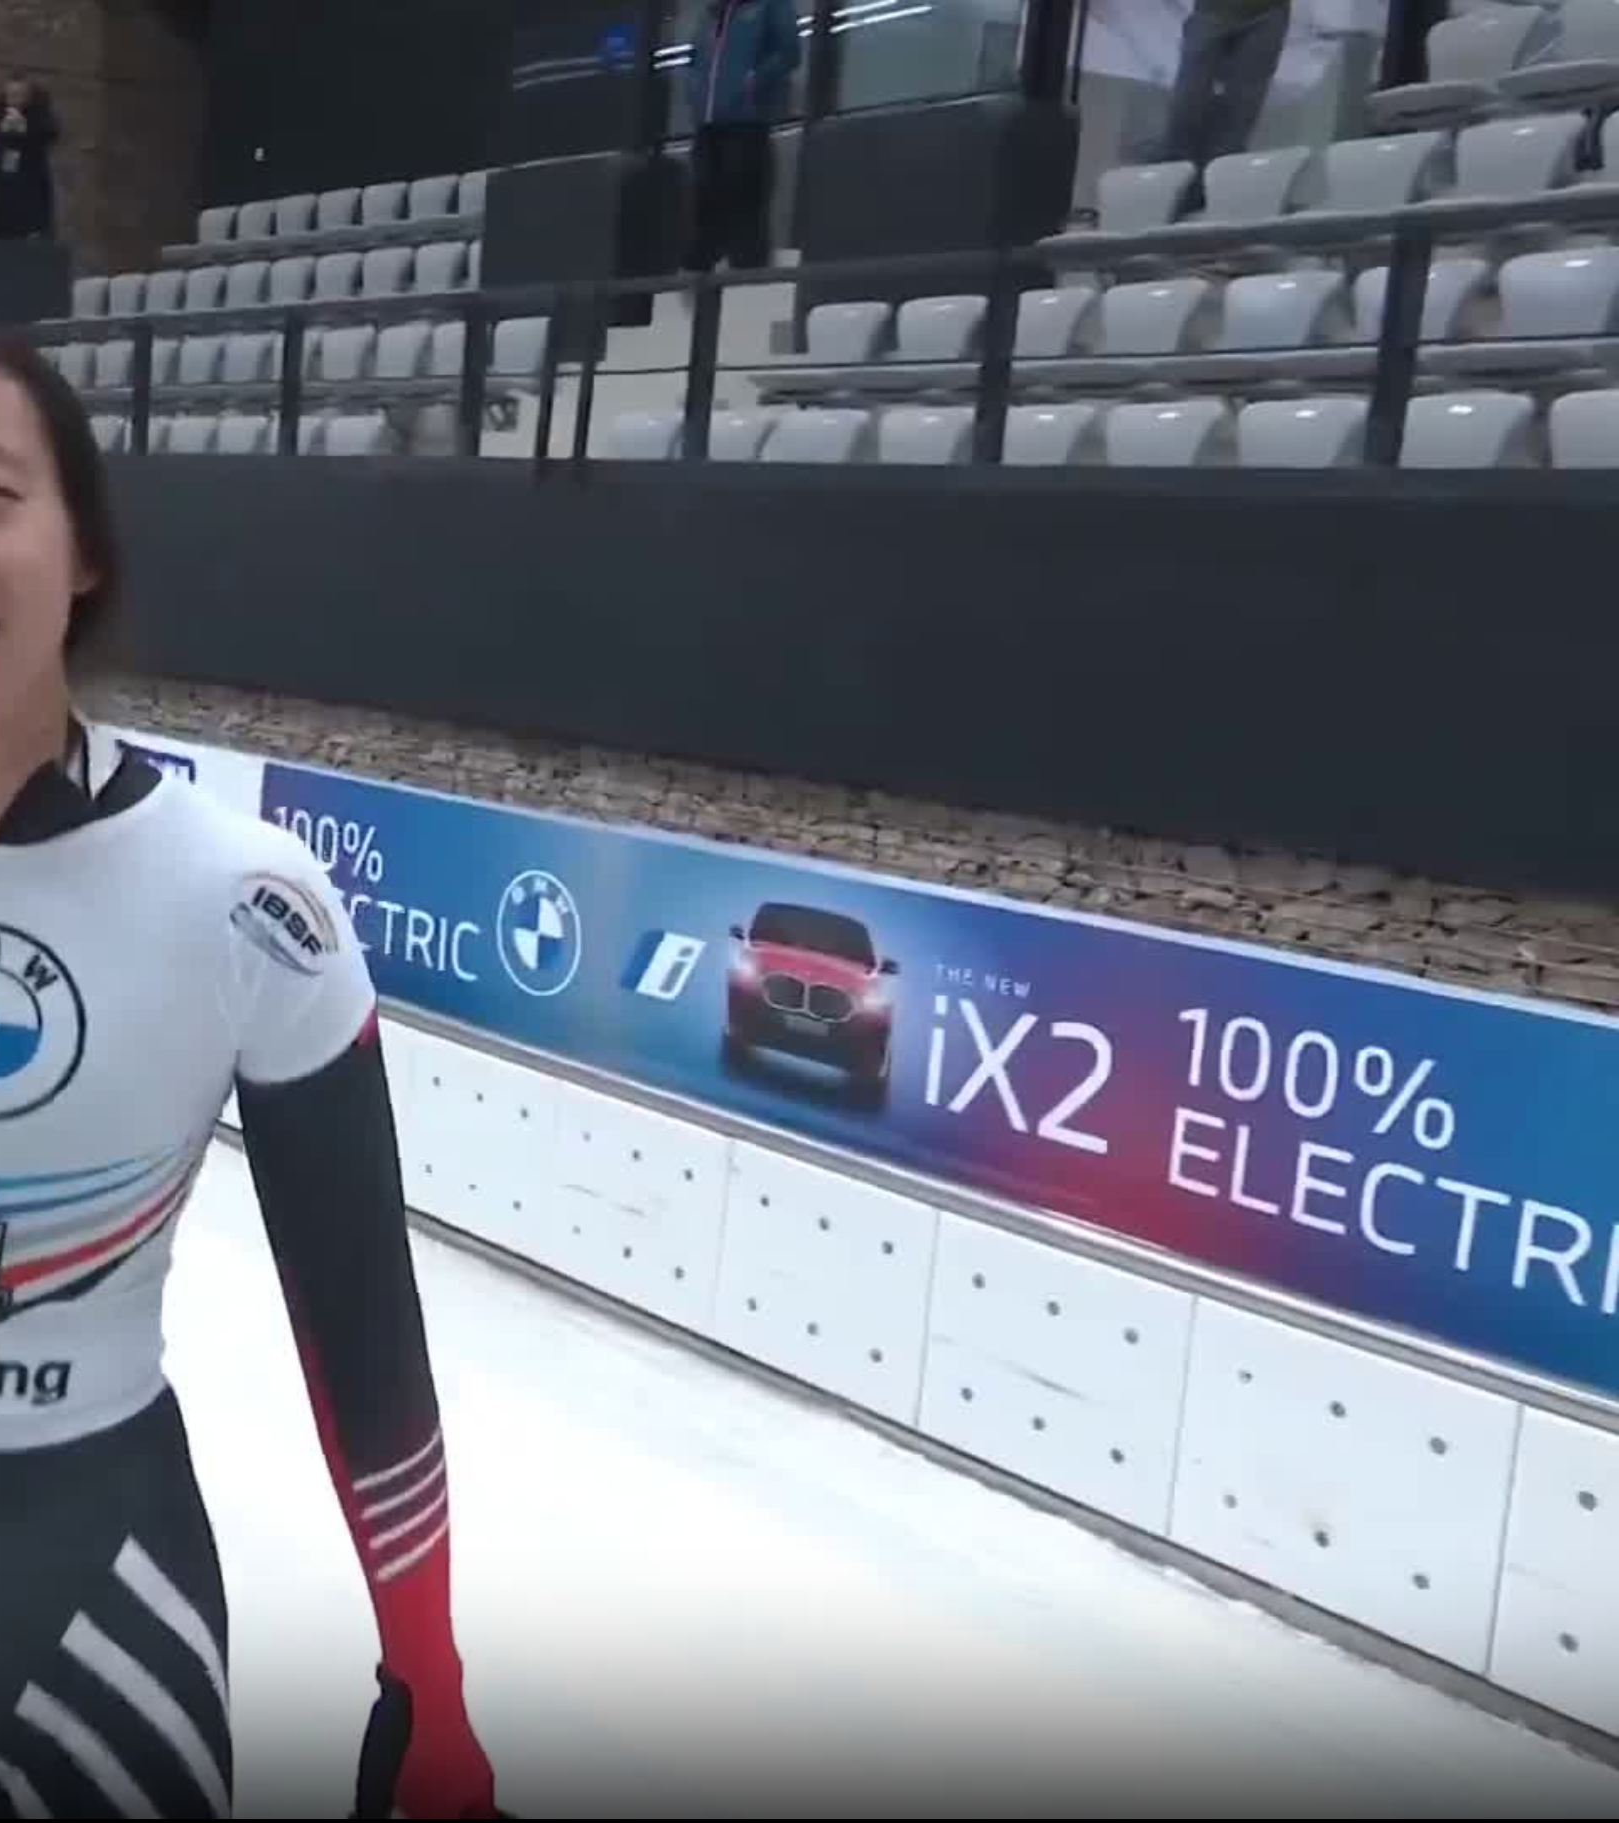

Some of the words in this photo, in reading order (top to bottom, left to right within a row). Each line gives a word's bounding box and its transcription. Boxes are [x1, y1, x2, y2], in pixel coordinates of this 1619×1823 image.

[251, 886, 324, 956] IBSF
[933, 962, 974, 986] THE
[984, 973, 1031, 998] NEW
[925, 994, 1113, 1155] iX2
[1179, 1006, 1455, 1150] 100%
